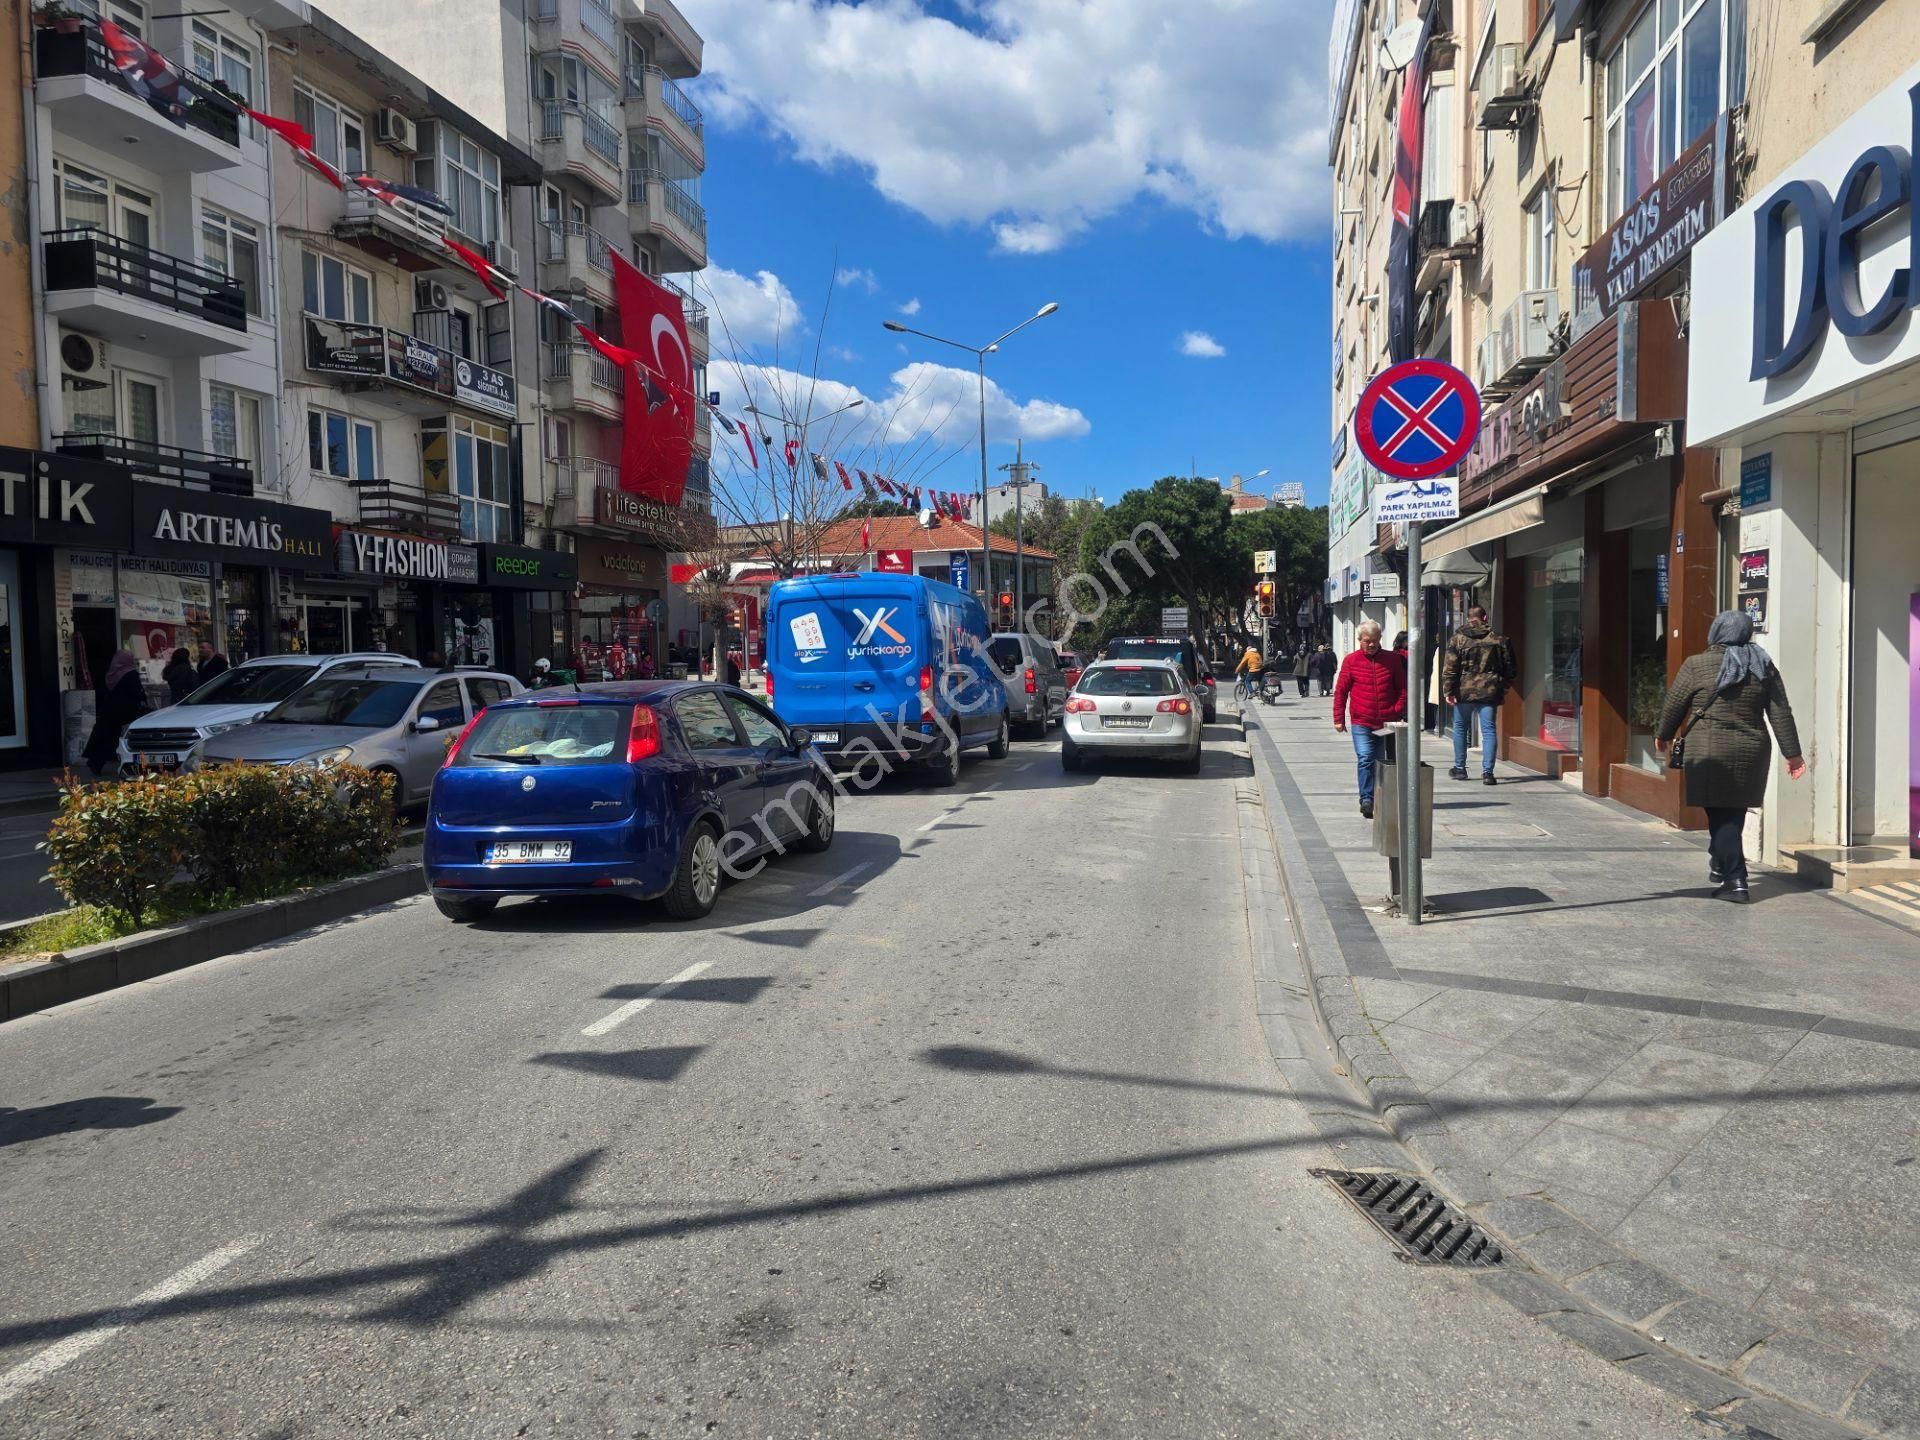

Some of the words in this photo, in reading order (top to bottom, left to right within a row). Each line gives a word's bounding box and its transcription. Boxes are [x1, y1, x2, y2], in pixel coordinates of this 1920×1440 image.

[1606, 188, 1661, 273] ASOS
[1606, 264, 1635, 307] YAPI
[1639, 201, 1706, 284] DENETİM
[1381, 503, 1404, 512] PARK
[1407, 500, 1452, 510] YAPILMAZ
[1377, 512, 1418, 522] ARACINIZ
[1420, 509, 1456, 519] ÇEKİLİR
[152, 508, 283, 551] ARTEMİS
[284, 537, 322, 556] HALI
[121, 558, 147, 571] MERT
[149, 560, 170, 572] HALI
[602, 553, 646, 573] vodafone
[494, 843, 509, 857] 35
[520, 843, 543, 857] BMM
[554, 842, 569, 857] 92
